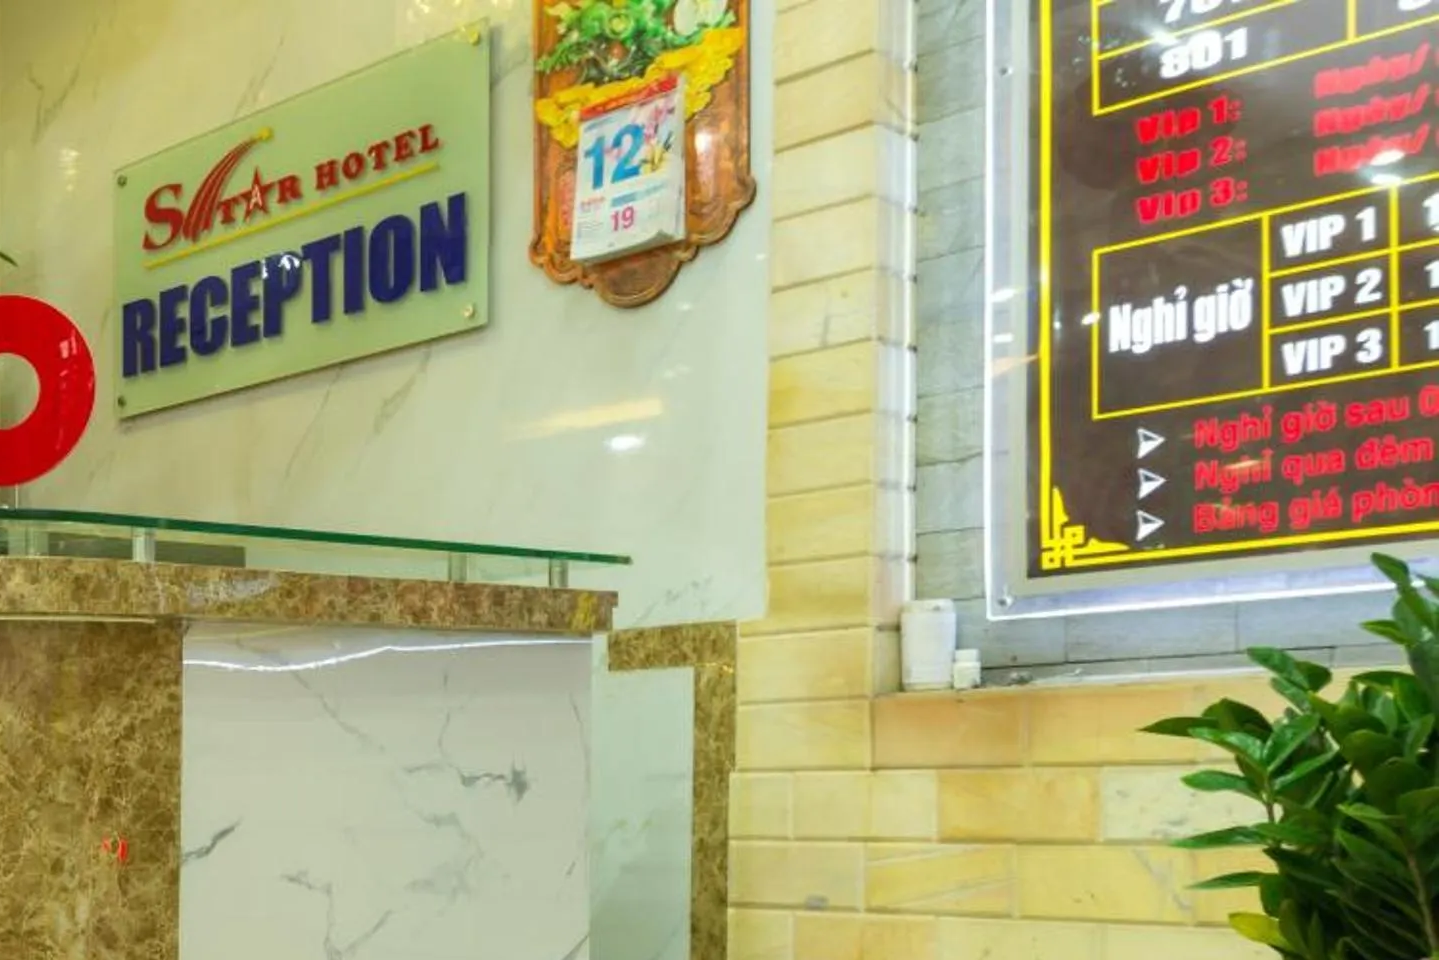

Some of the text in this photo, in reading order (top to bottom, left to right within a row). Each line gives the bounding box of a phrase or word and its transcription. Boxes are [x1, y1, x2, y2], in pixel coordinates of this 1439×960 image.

[1160, 27, 1248, 79] 801
[584, 123, 644, 190] 12
[142, 123, 441, 251] STAR HOTEL
[611, 205, 635, 231] 19
[1281, 206, 1377, 258] VIP 1
[122, 191, 468, 378] RECEPTION
[1281, 267, 1383, 317] VIP 2
[1109, 277, 1253, 354] Nghỉ giờ
[1281, 327, 1383, 376] VIP 3
[1345, 396, 1410, 428] sau
[1282, 449, 1345, 486] qua
[1355, 434, 1434, 470] đêm
[1288, 486, 1343, 530] giá
